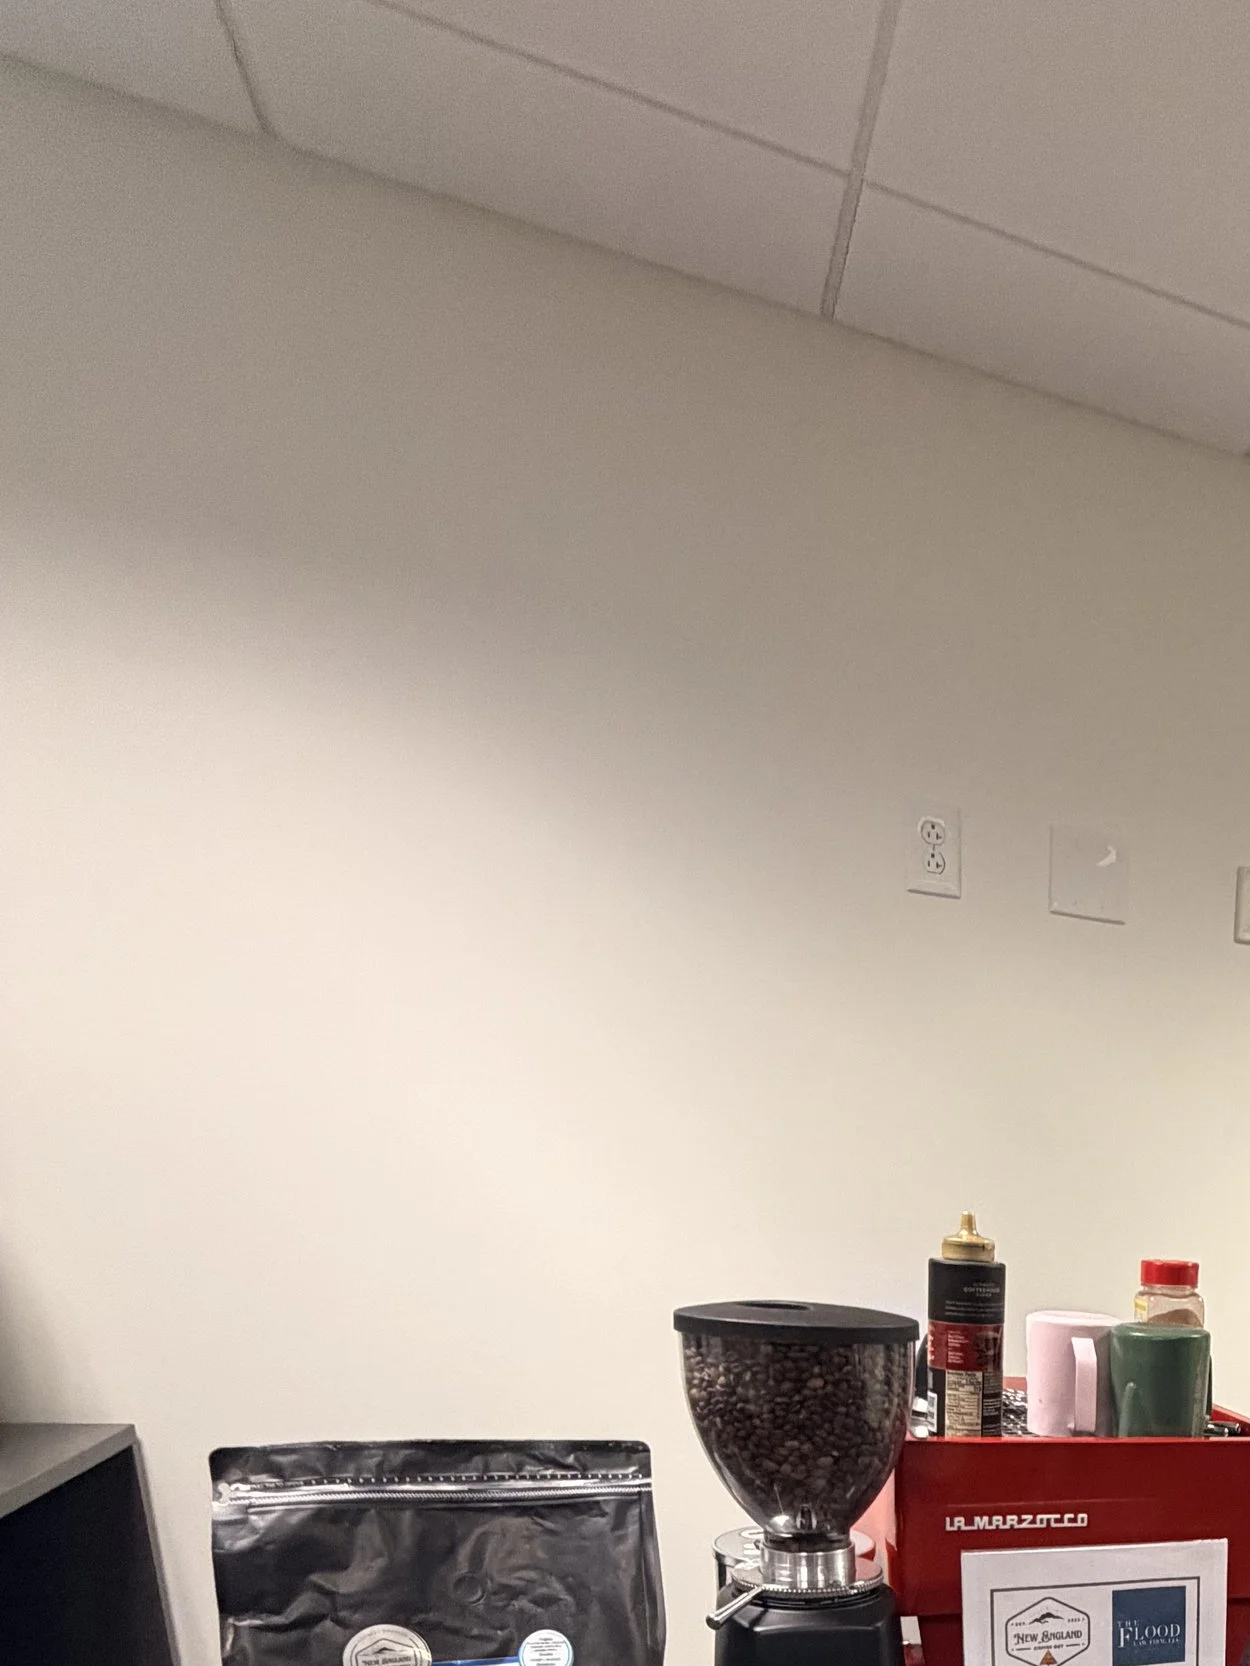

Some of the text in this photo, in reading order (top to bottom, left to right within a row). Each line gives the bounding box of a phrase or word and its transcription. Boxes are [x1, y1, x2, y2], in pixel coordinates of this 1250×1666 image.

[945, 1513, 1088, 1532] LA MARZOCCO
[1038, 1630, 1083, 1644] ENGLAND
[1118, 1623, 1181, 1649] FLOOD
